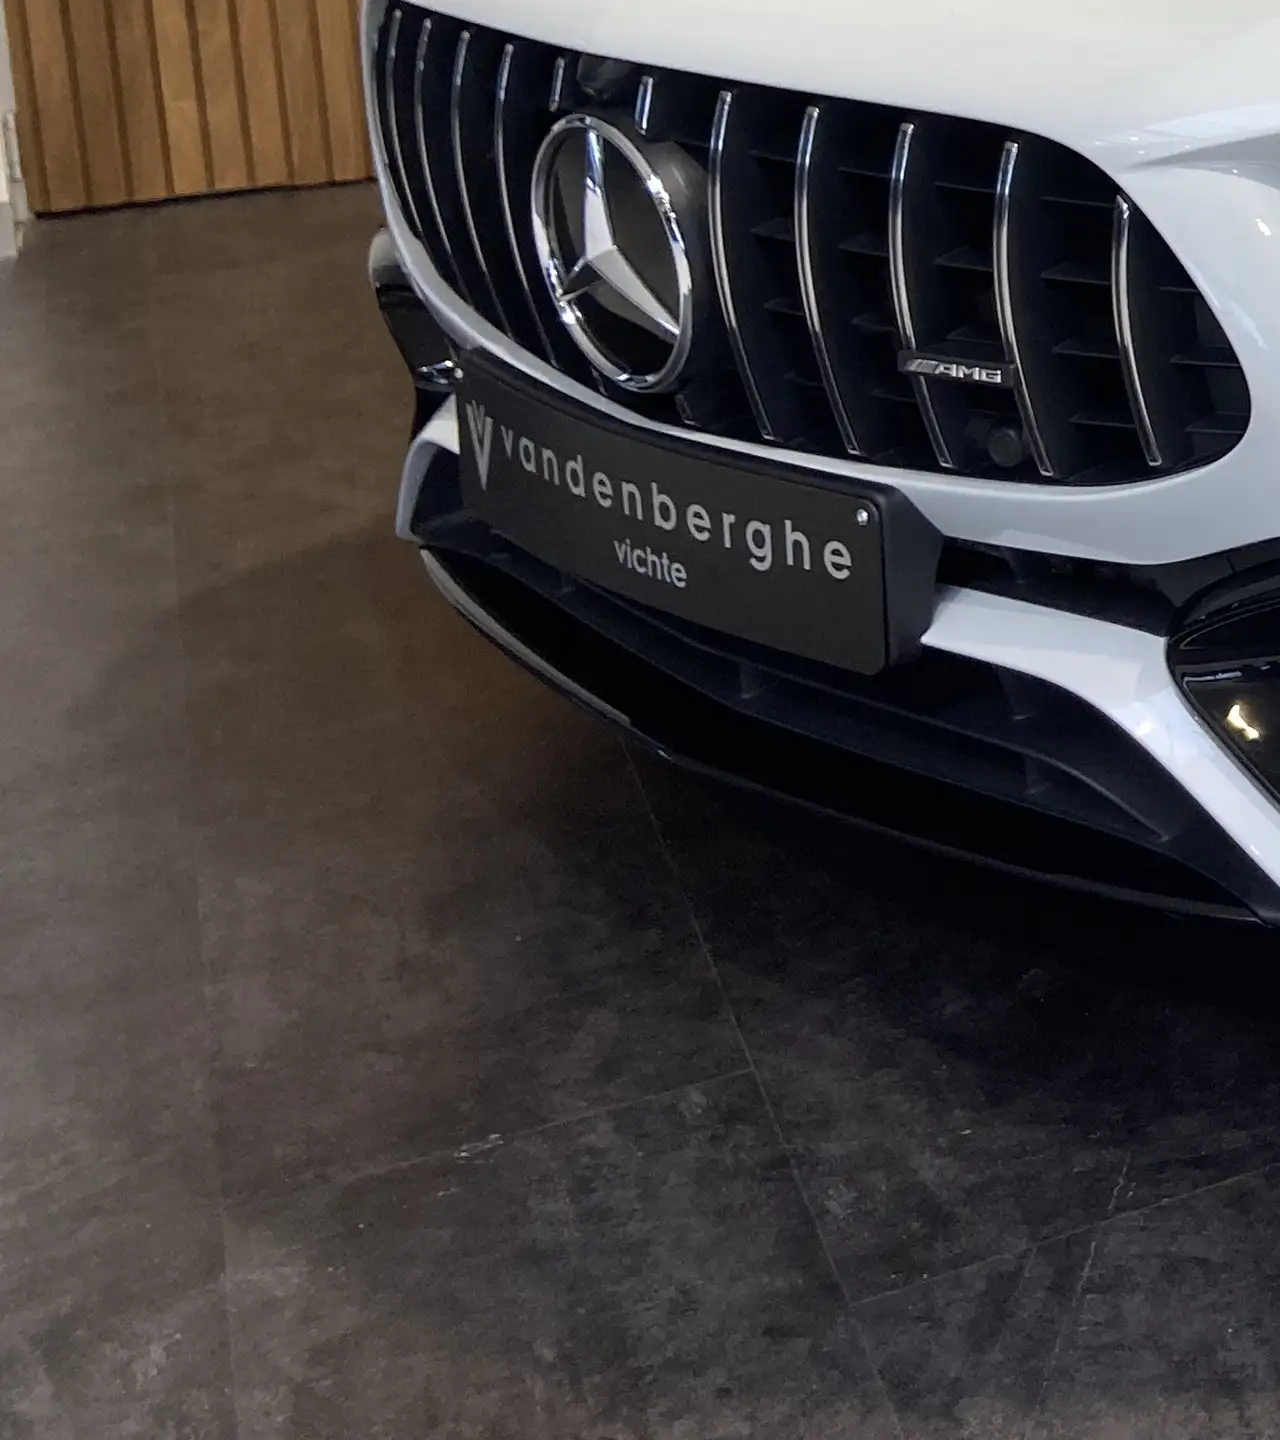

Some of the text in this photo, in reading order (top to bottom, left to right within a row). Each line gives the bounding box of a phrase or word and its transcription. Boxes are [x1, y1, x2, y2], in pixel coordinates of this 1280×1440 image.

[934, 363, 1002, 384] AMG
[502, 424, 853, 581] vandenberghe
[614, 537, 688, 589] vichte
